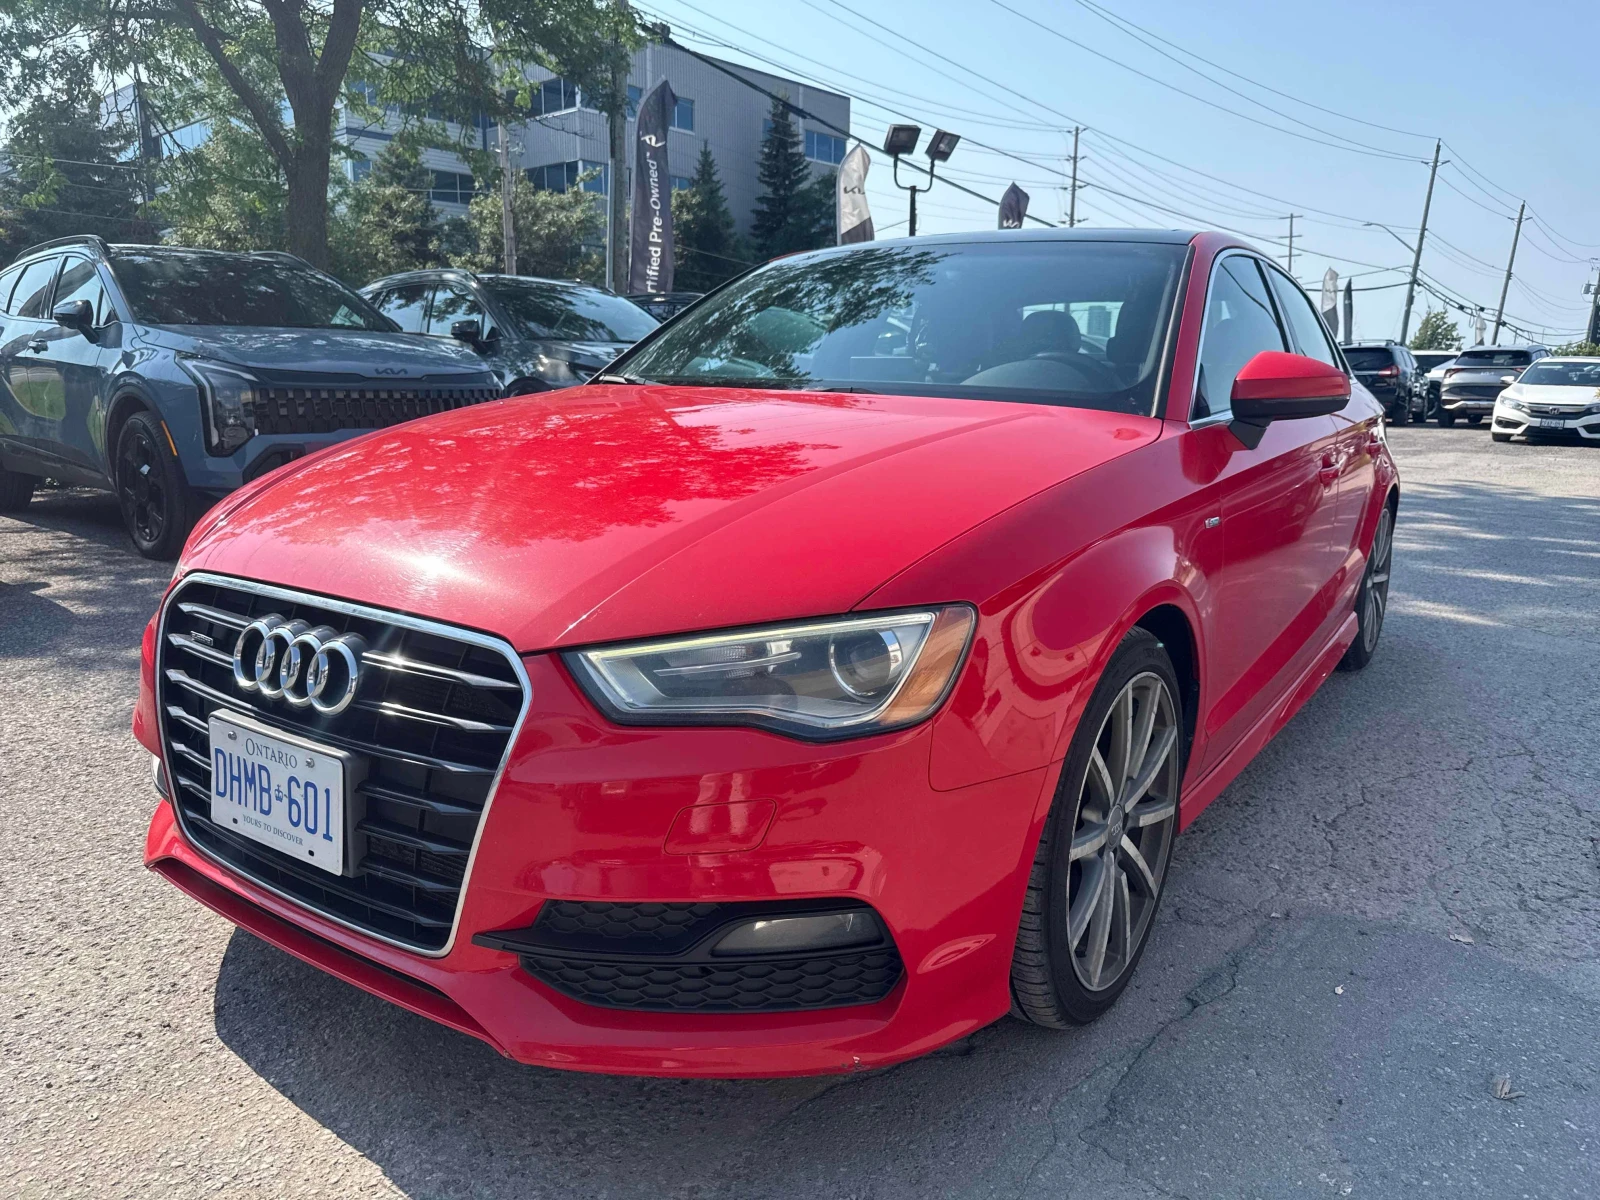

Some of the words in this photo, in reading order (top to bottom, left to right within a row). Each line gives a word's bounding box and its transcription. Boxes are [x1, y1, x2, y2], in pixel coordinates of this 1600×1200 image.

[646, 246, 662, 293] rtified
[245, 739, 298, 770] ONTARIO
[214, 747, 272, 816] DHMB
[287, 775, 333, 842] 601
[243, 814, 262, 829] YOURS
[263, 824, 272, 833] TO
[273, 827, 303, 846] DISCOVER
